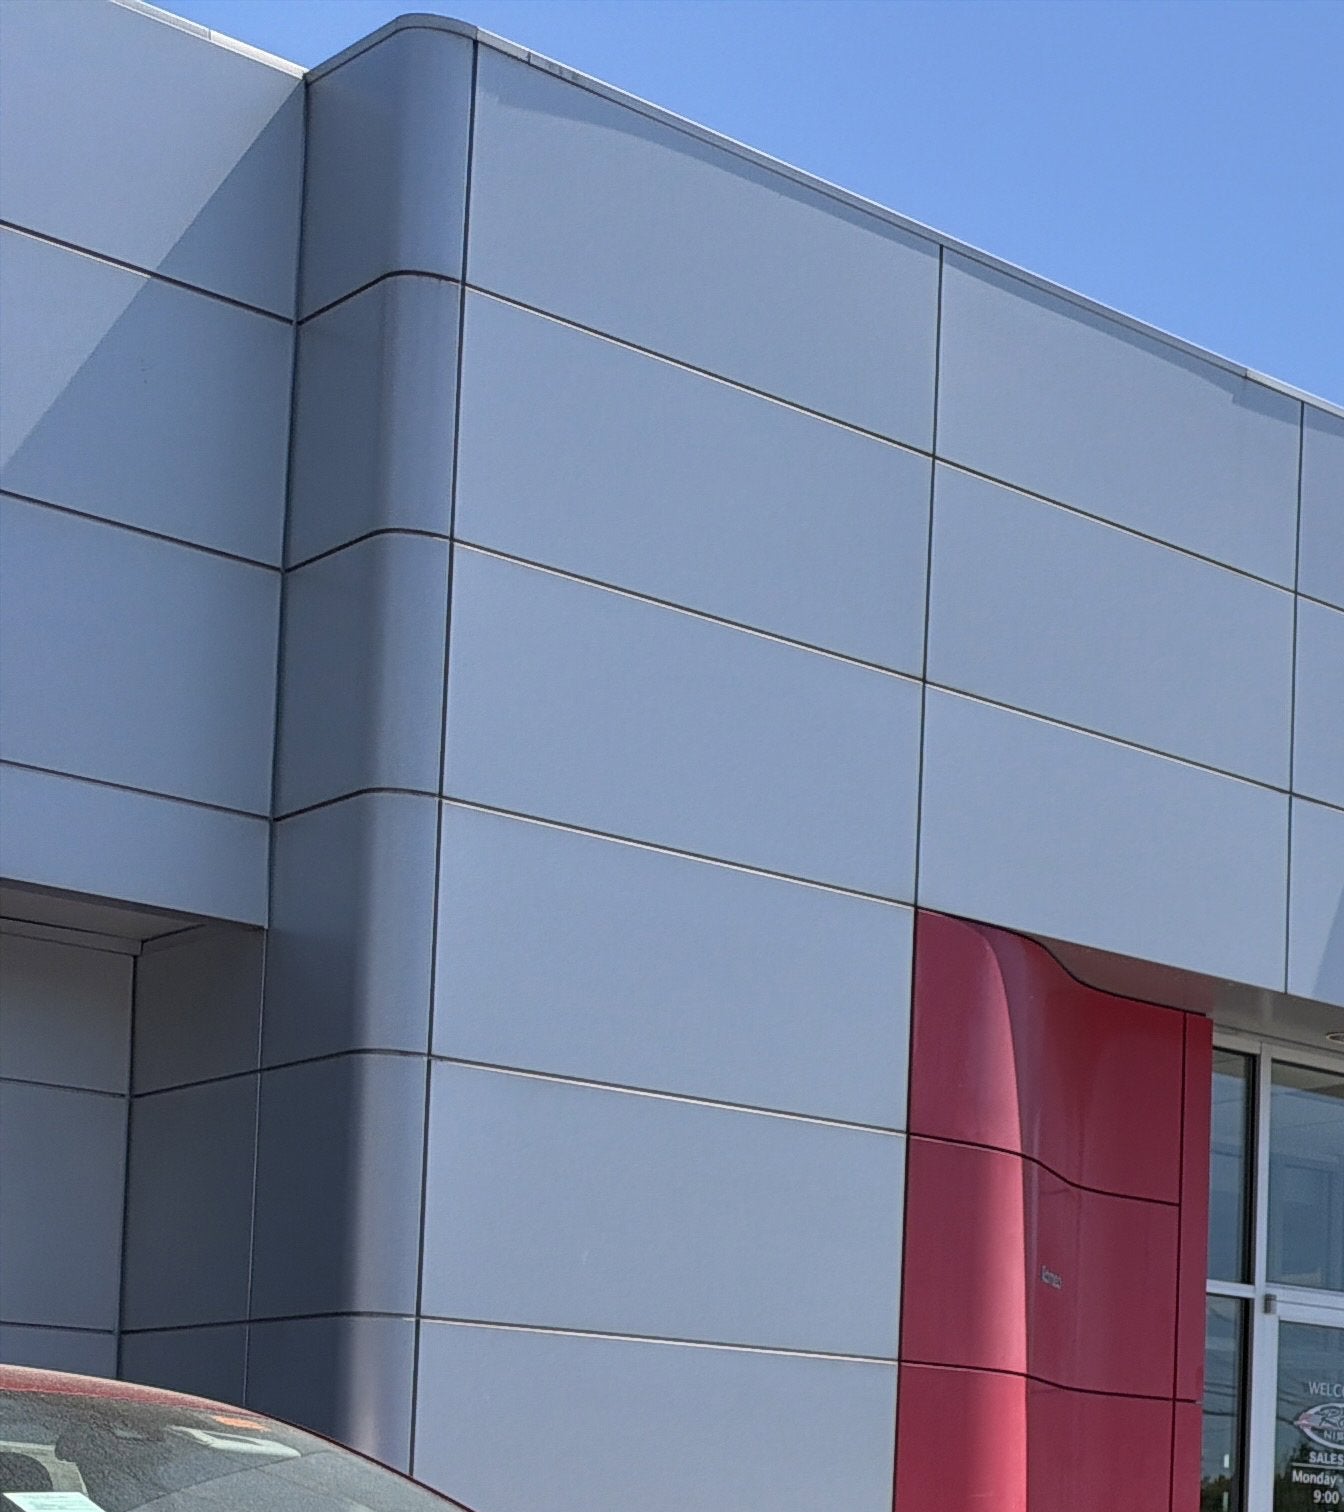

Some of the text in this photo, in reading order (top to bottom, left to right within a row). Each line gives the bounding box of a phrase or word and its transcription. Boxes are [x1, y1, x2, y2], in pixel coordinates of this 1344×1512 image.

[1308, 1451, 1344, 1466] SALES
[1291, 1469, 1338, 1488] Monday
[1313, 1489, 1340, 1504] 9:00
